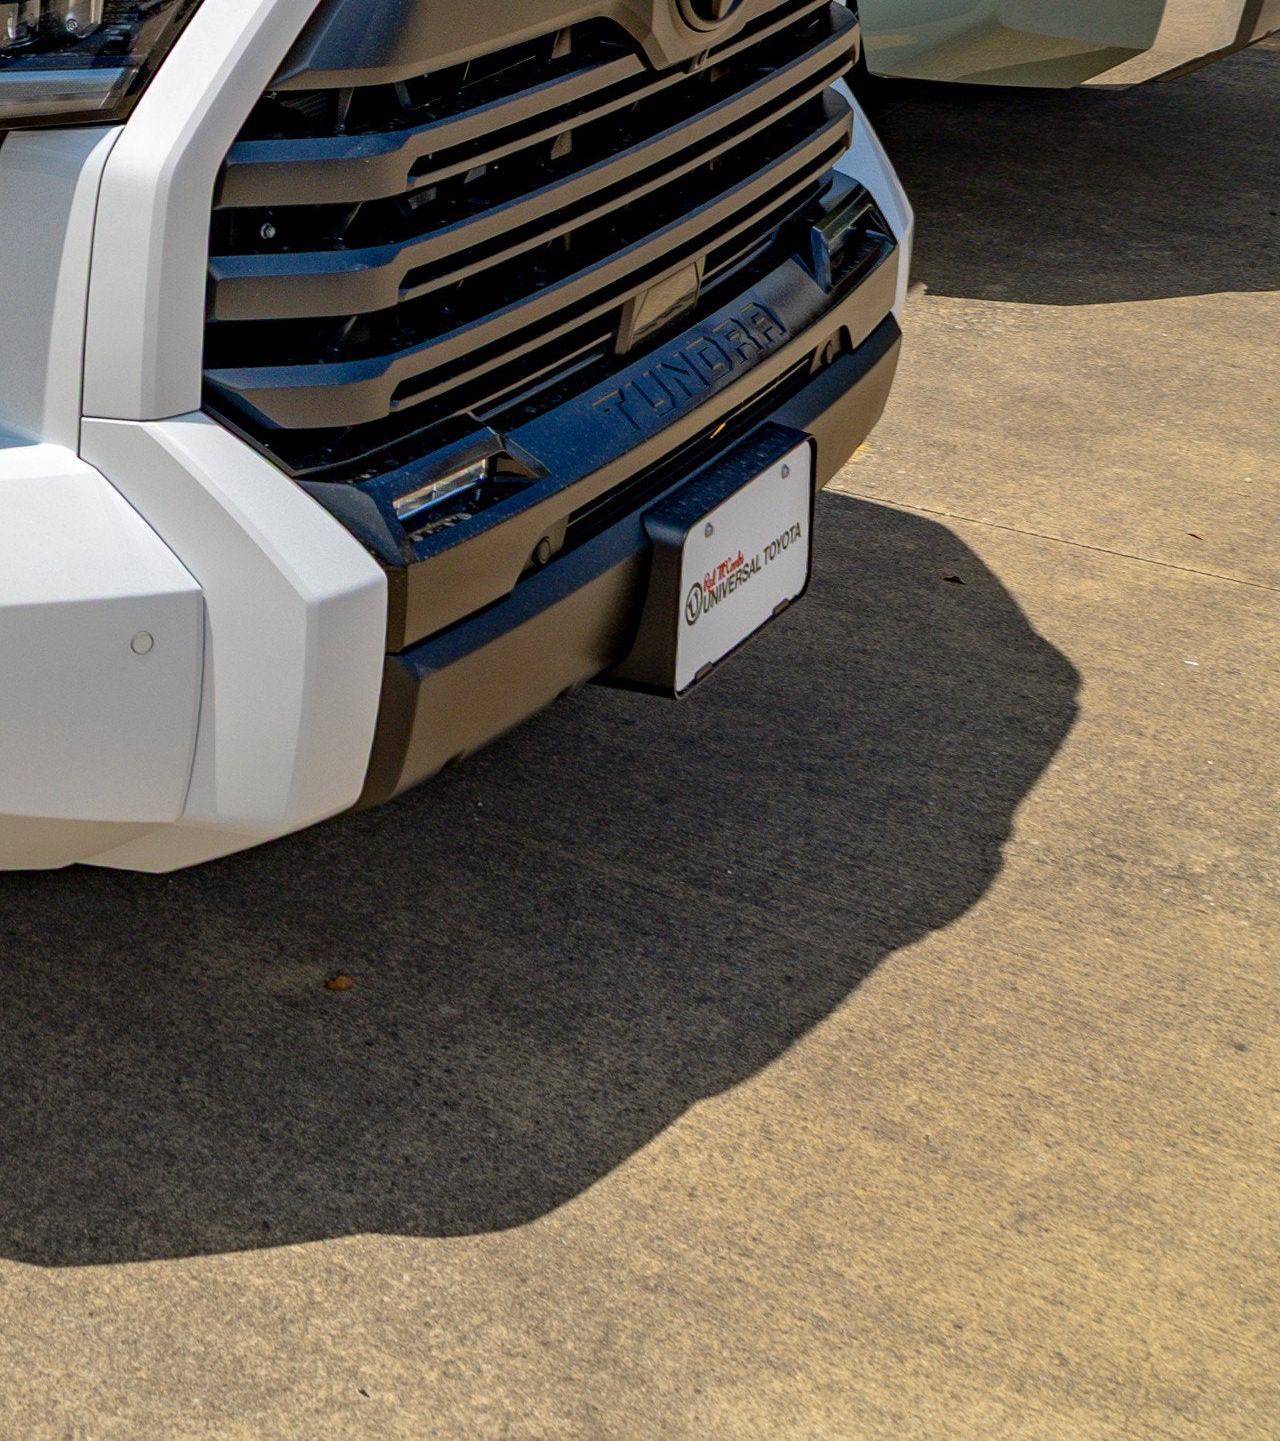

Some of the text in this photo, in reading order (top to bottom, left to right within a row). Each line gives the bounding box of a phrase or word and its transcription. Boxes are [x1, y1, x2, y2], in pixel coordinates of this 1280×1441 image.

[592, 301, 789, 433] TUNDRA
[703, 521, 801, 613] UNIVERSAL TOYOTA
